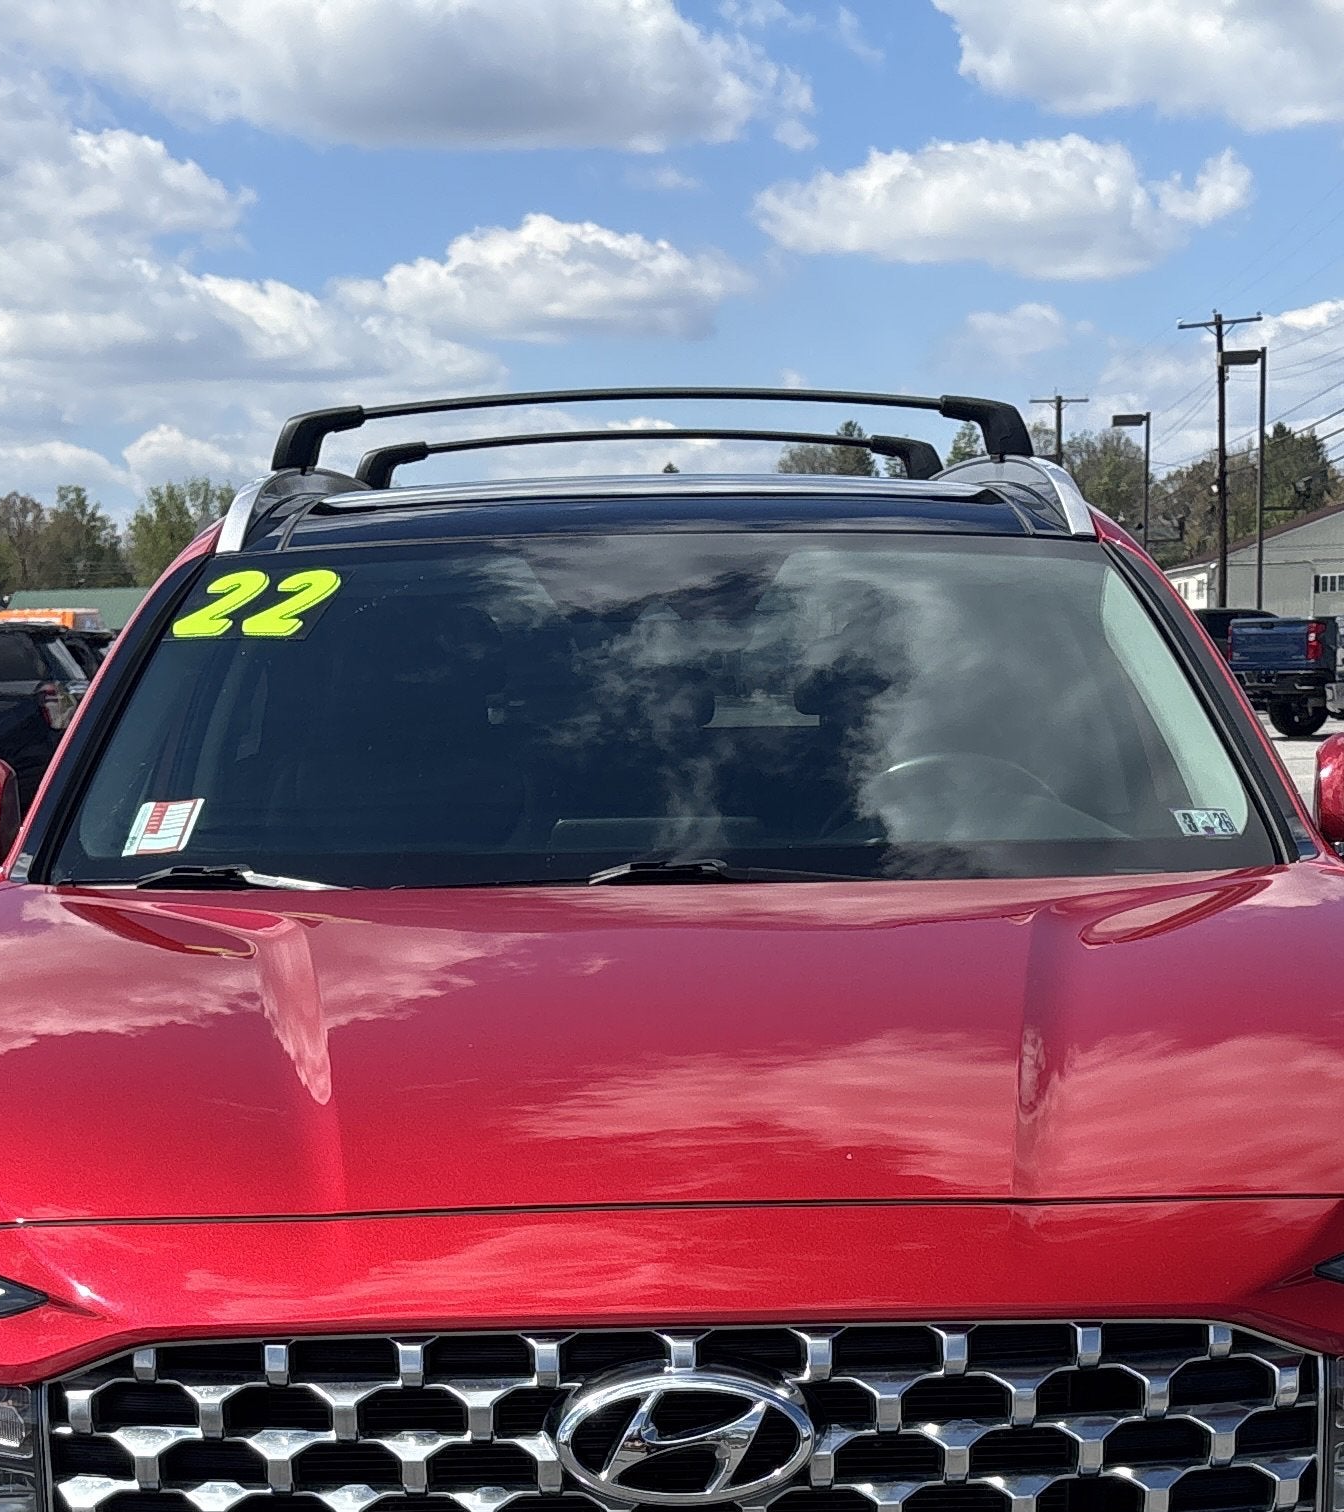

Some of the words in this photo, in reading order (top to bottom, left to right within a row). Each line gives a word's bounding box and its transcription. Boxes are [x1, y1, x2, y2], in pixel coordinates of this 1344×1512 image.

[172, 569, 342, 638] 22
[1181, 812, 1199, 833] 3
[1213, 812, 1239, 833] 26
